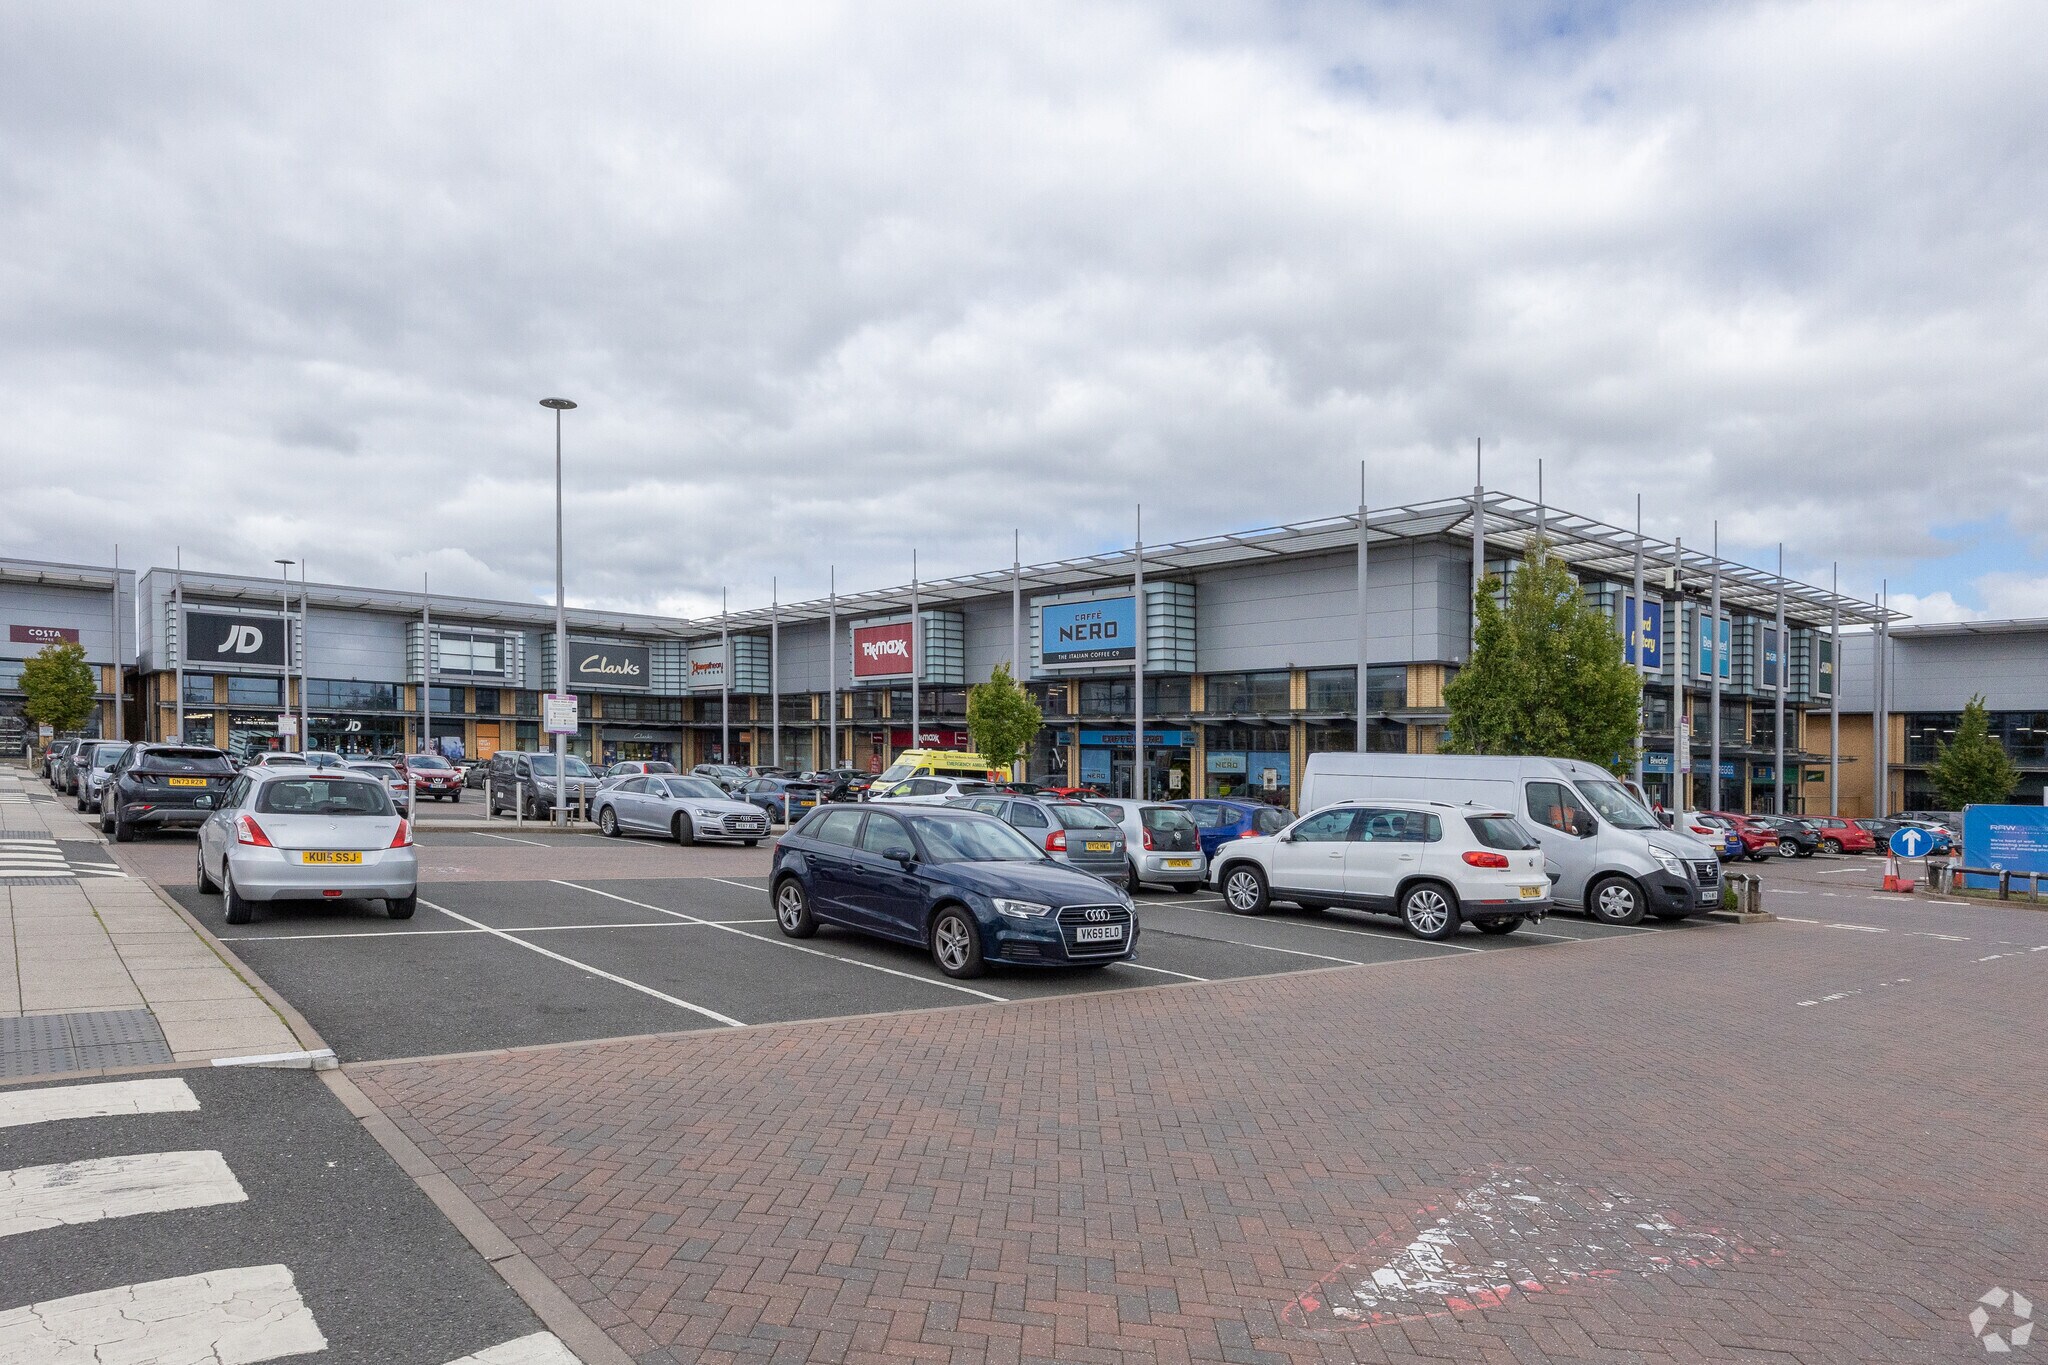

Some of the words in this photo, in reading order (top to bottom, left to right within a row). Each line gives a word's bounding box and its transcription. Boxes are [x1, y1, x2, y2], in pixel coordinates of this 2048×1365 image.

[28, 628, 61, 637] COSTA
[1059, 621, 1118, 642] NERO
[217, 625, 263, 654] JD
[579, 654, 640, 675] Clarks
[345, 720, 361, 732] JD
[309, 852, 333, 862] KU15
[335, 852, 356, 862] SSJ
[1080, 928, 1103, 940] VK69
[1104, 926, 1120, 938] ELO
